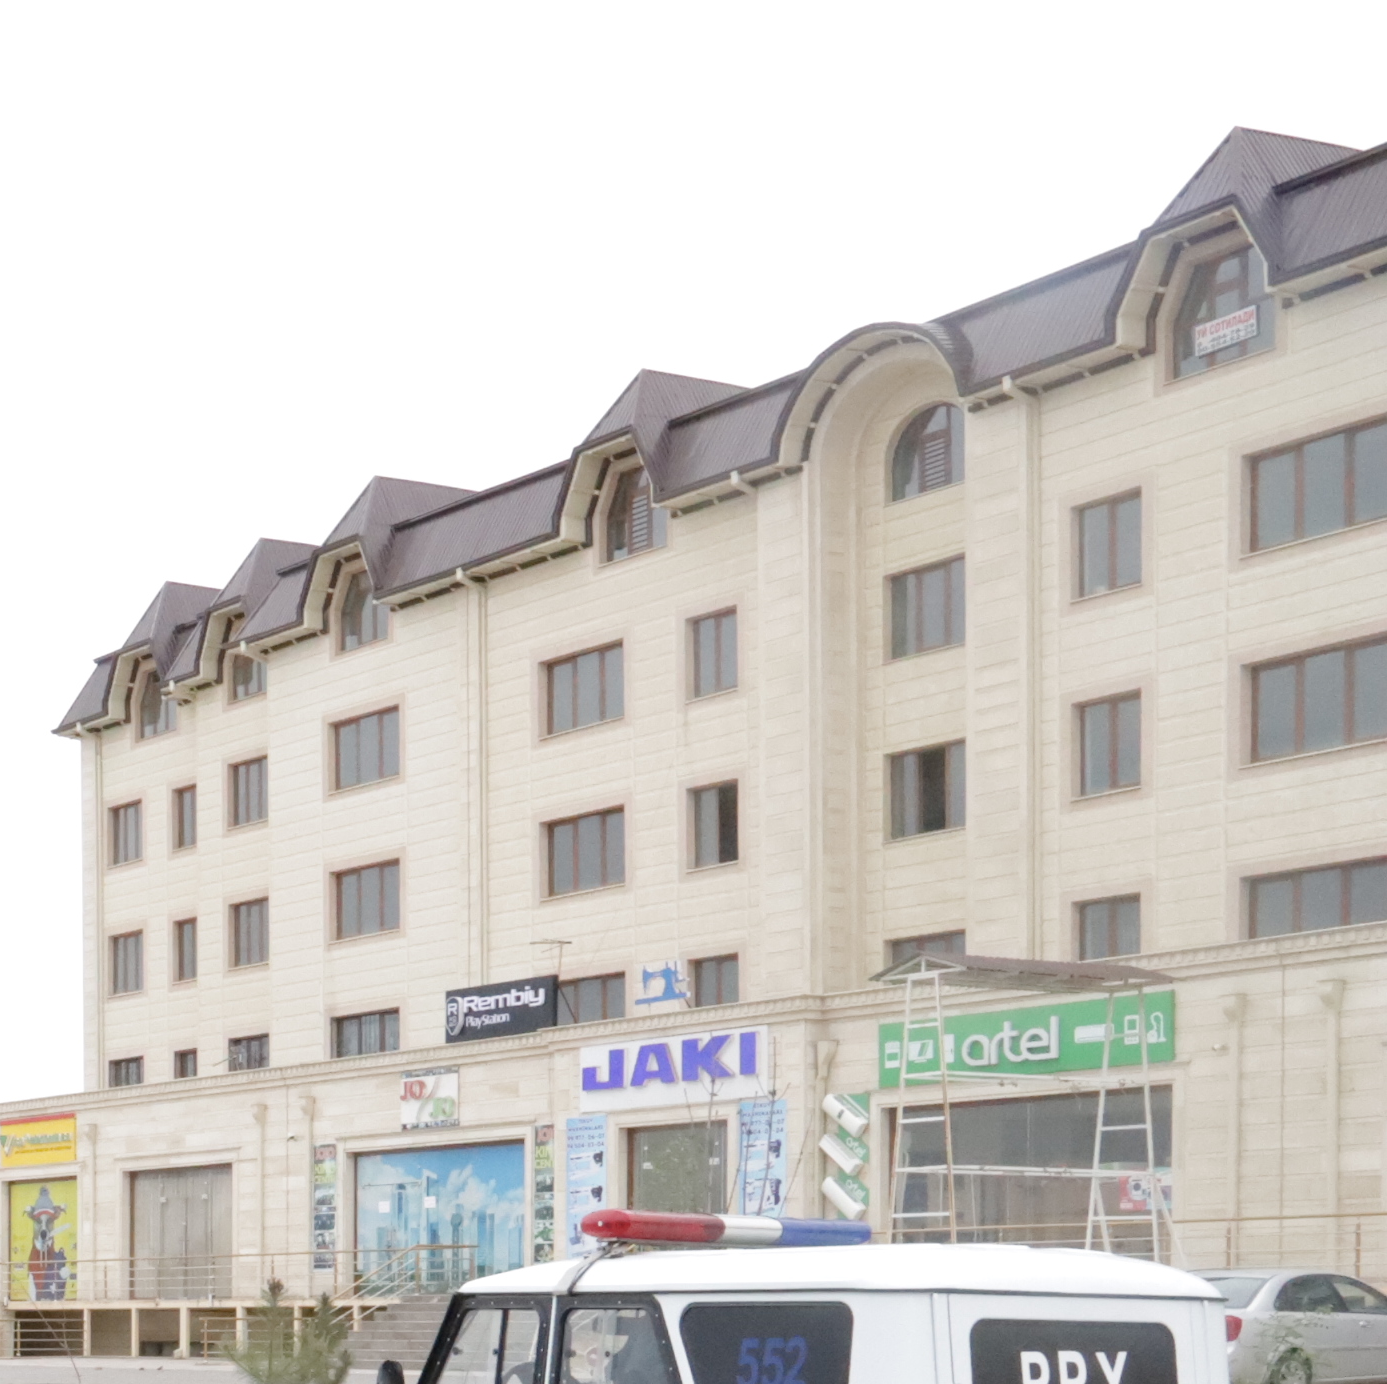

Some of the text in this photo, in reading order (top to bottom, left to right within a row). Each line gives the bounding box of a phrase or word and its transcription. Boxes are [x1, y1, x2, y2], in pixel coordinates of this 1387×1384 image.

[463, 985, 545, 1013] Rembiy
[465, 1013, 510, 1029] PlayStation
[961, 1015, 1060, 1067] artel
[582, 1031, 759, 1091] JAKI
